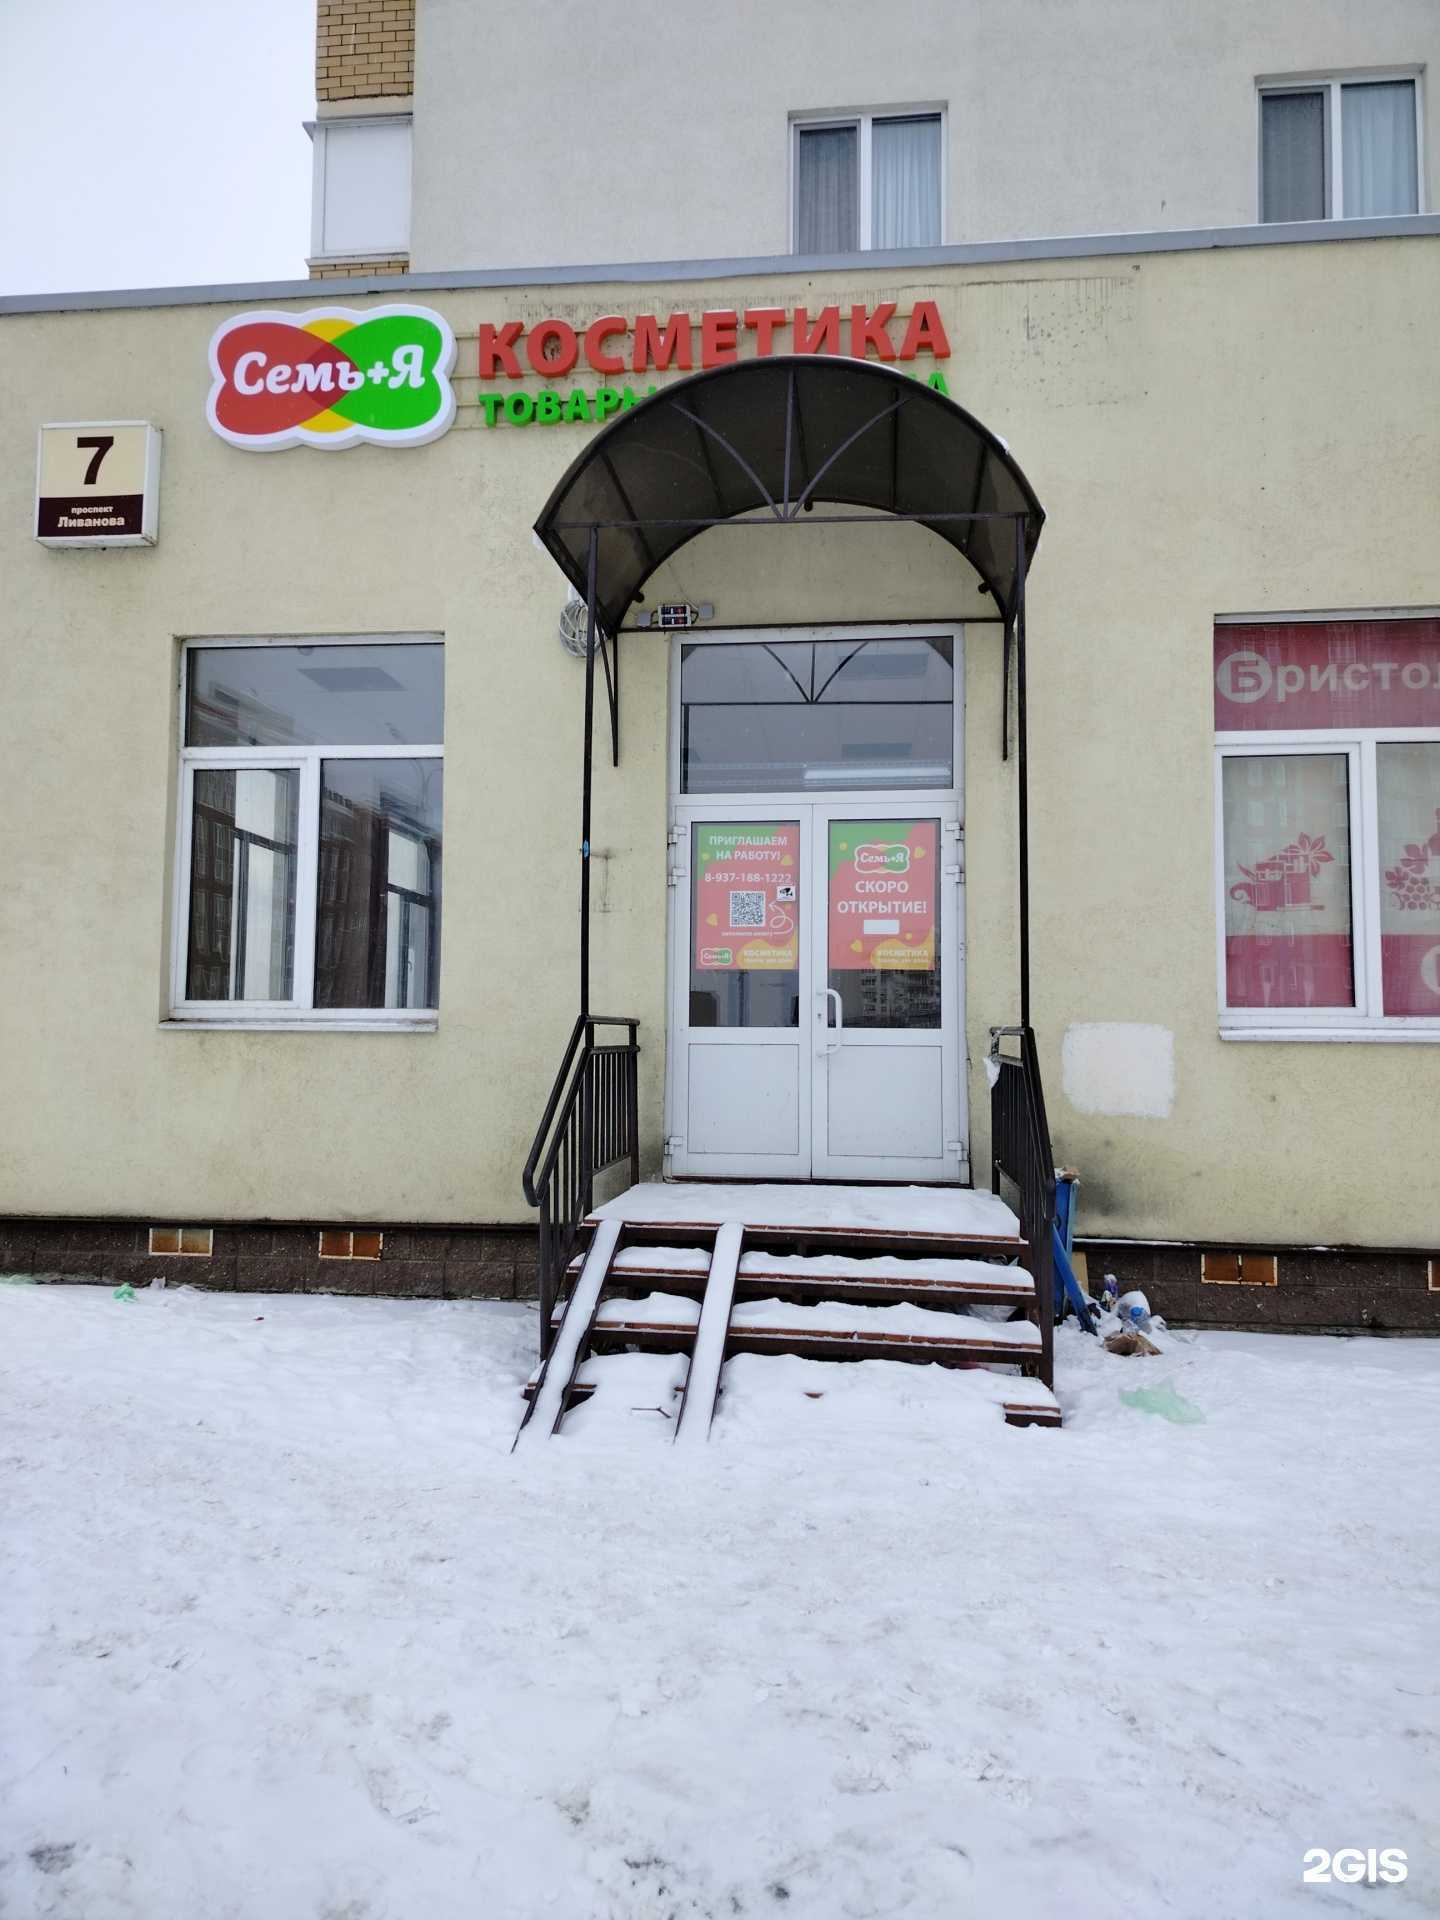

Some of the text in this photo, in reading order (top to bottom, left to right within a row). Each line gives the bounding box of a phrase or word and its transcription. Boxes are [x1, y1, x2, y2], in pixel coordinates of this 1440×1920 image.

[479, 300, 951, 379] КОСМЕТИКА
[233, 344, 426, 395] Семь+Я
[77, 435, 114, 485] 7
[71, 506, 114, 515] проспект
[57, 516, 125, 528] Ливанова
[1220, 654, 1440, 703] Бристо
[709, 835, 788, 846] ПРИГЛАШАЕМ
[716, 850, 780, 861] НА РАБОТУ!
[855, 880, 910, 893] СКОРО
[836, 901, 928, 914] ОТКРЫТИЕ!
